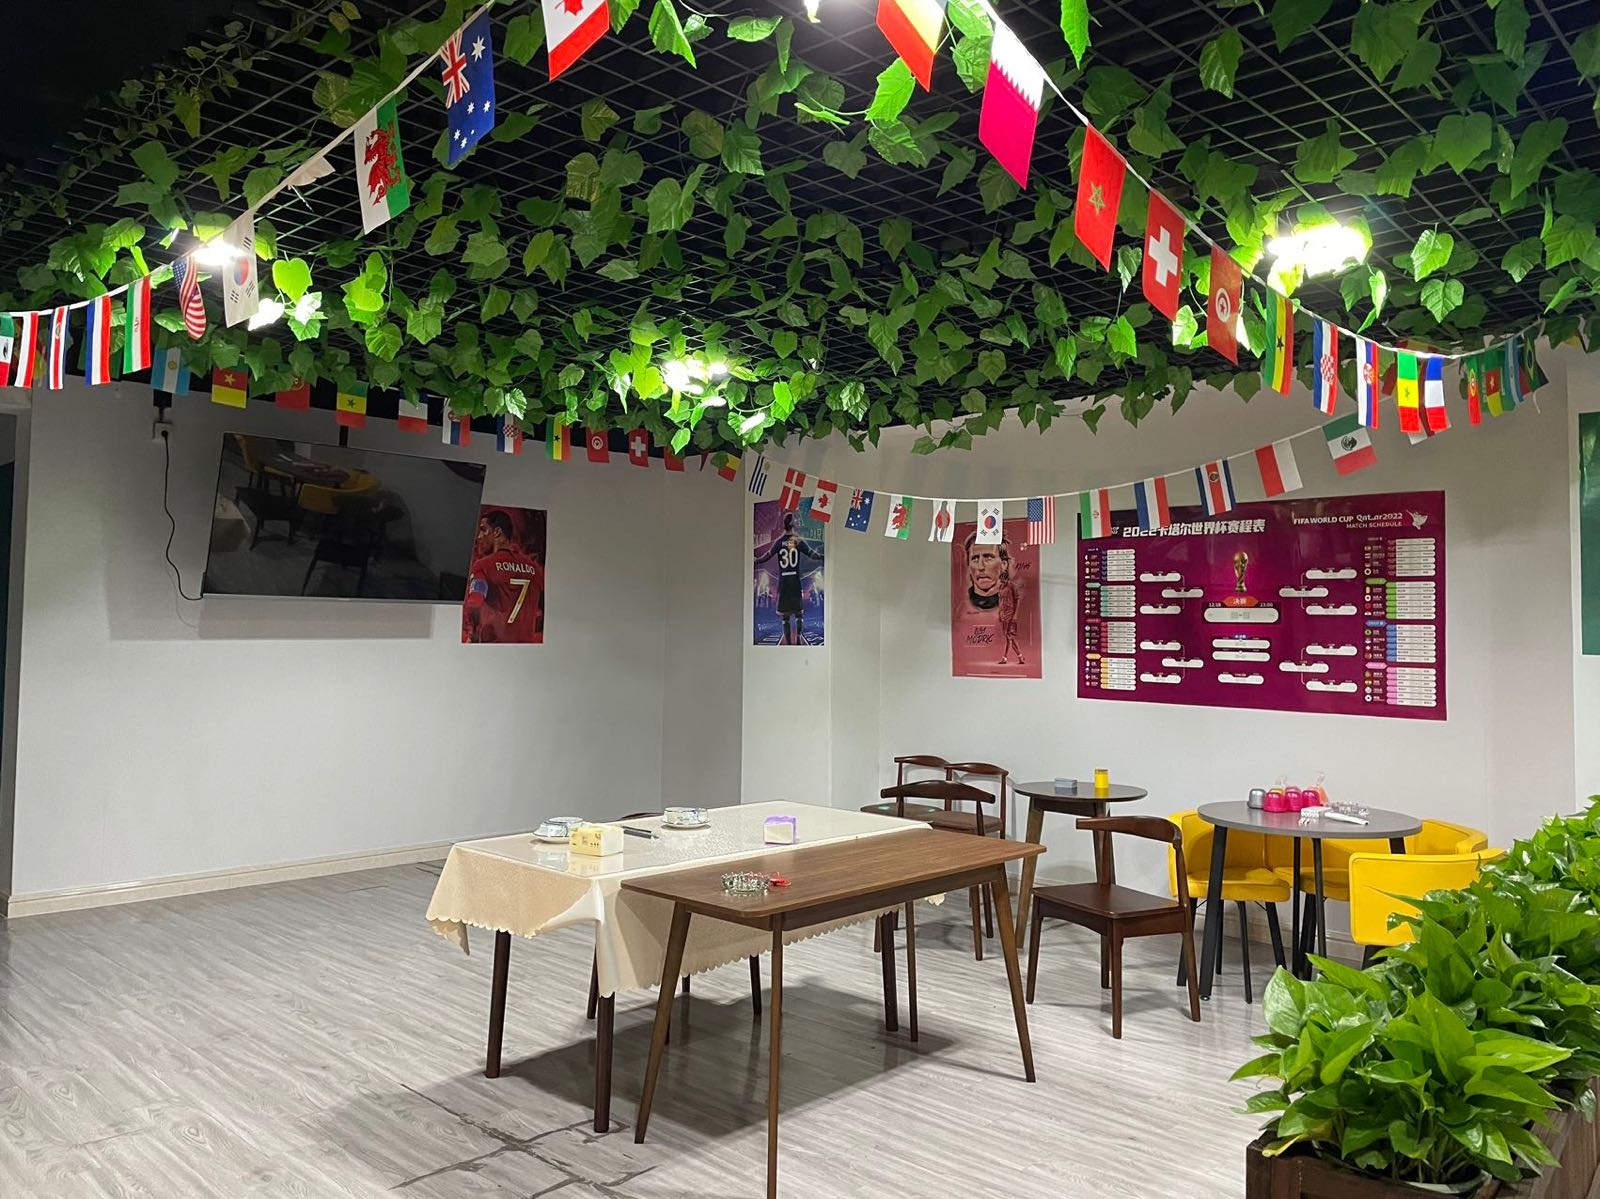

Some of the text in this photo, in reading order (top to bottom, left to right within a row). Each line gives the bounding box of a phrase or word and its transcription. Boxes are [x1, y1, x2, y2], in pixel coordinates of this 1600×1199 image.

[1293, 517, 1309, 525] FIFA
[1310, 516, 1338, 524] WORLD
[1339, 515, 1354, 523] CUP
[779, 548, 799, 569] 30
[495, 562, 536, 575] RONALDO
[506, 578, 531, 624] 7
